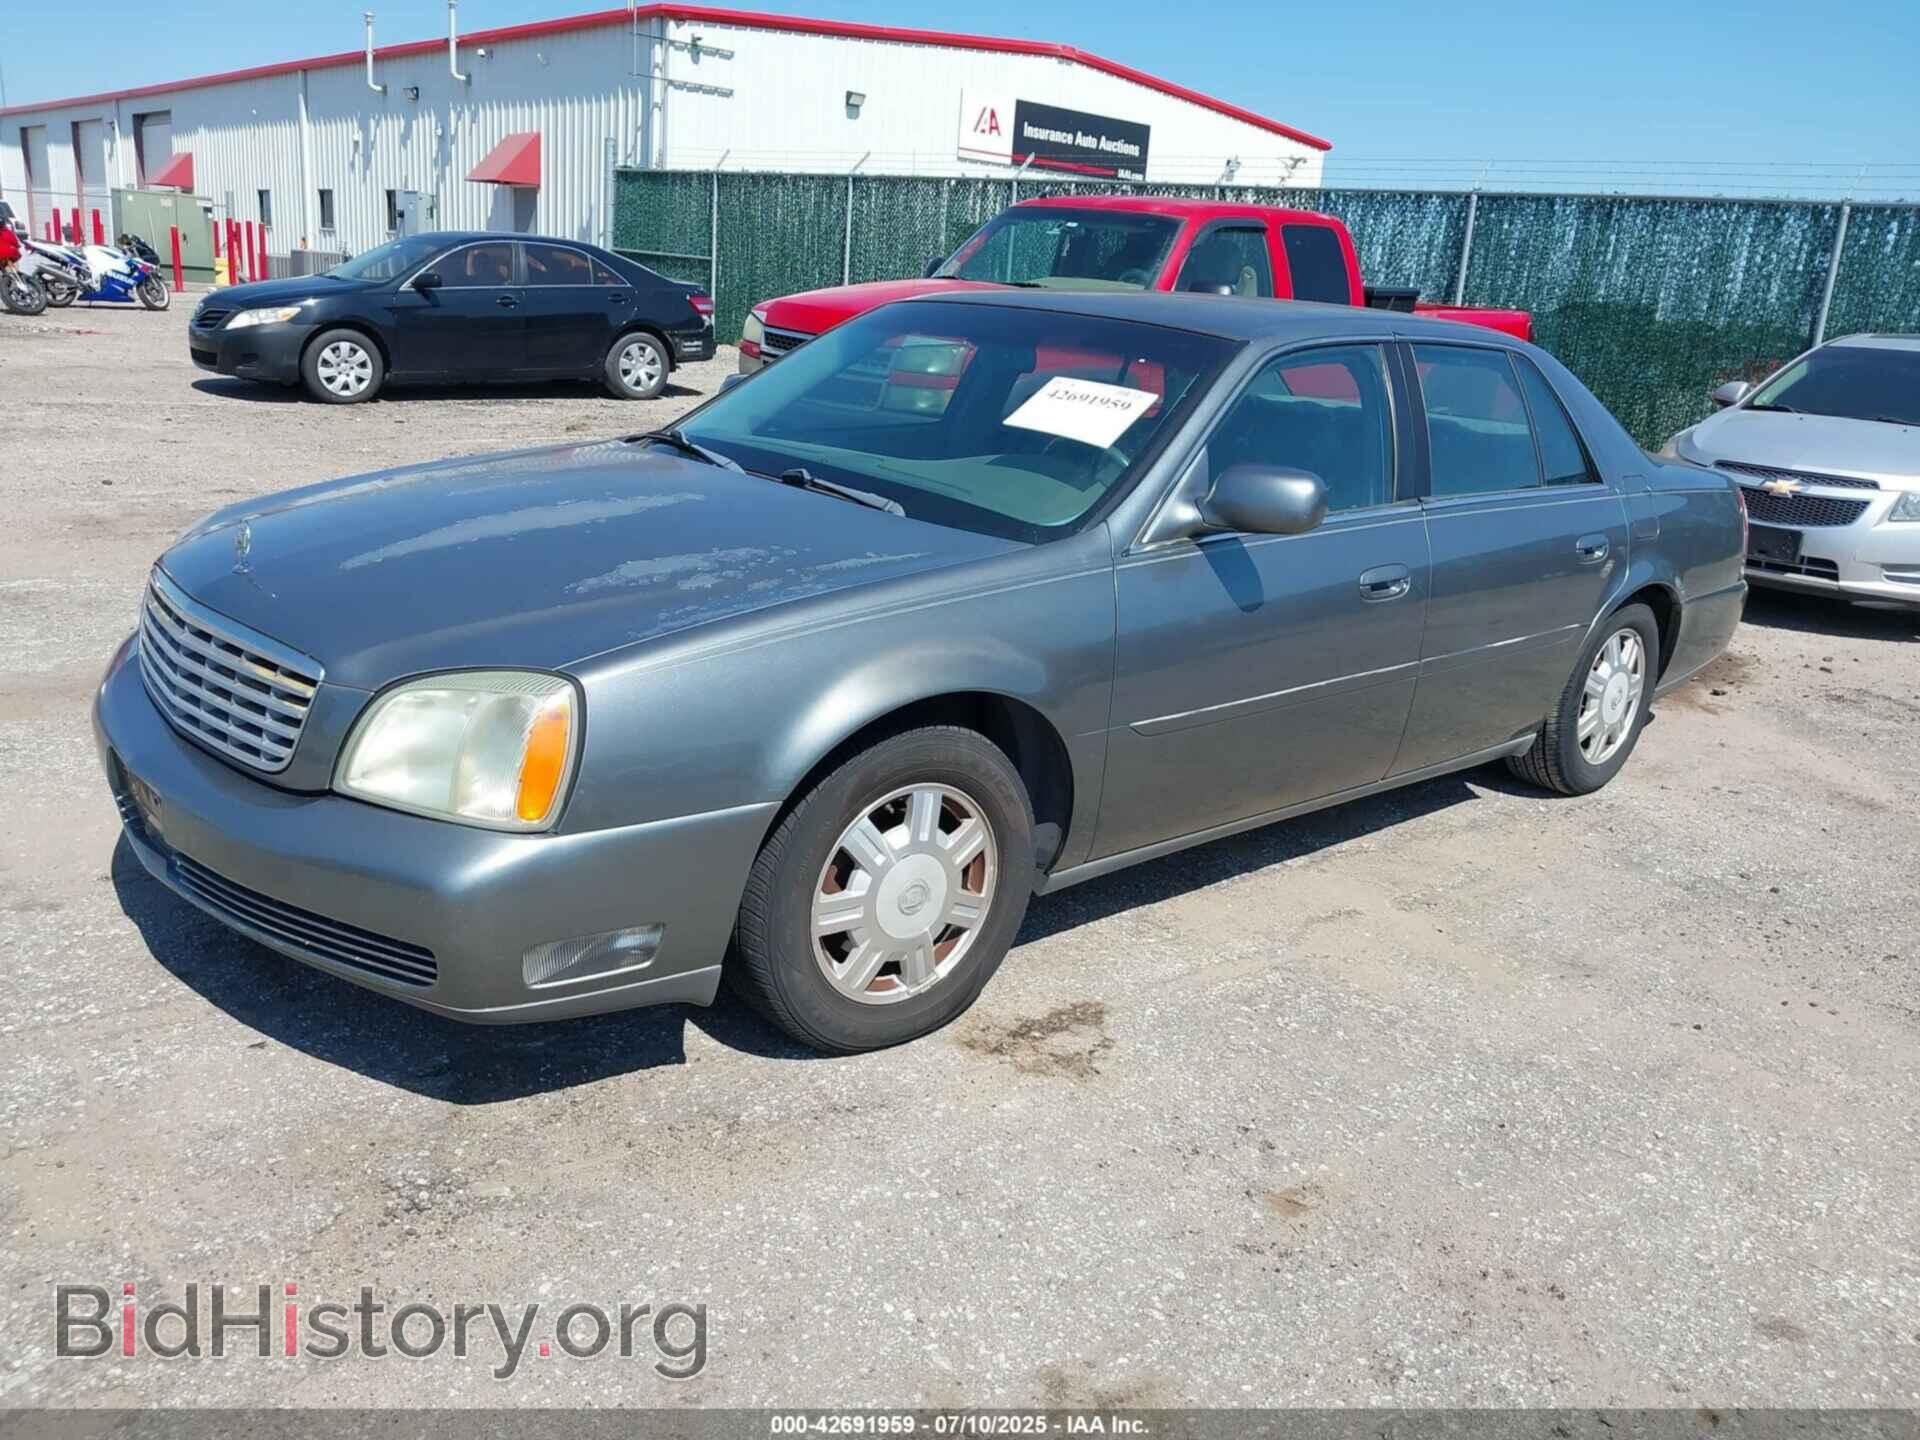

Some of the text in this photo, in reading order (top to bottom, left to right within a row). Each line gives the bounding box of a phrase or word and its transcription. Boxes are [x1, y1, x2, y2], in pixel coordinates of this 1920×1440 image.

[1023, 121, 1140, 157] Insurance Auto Auctions
[1047, 389, 1132, 409] 42691959
